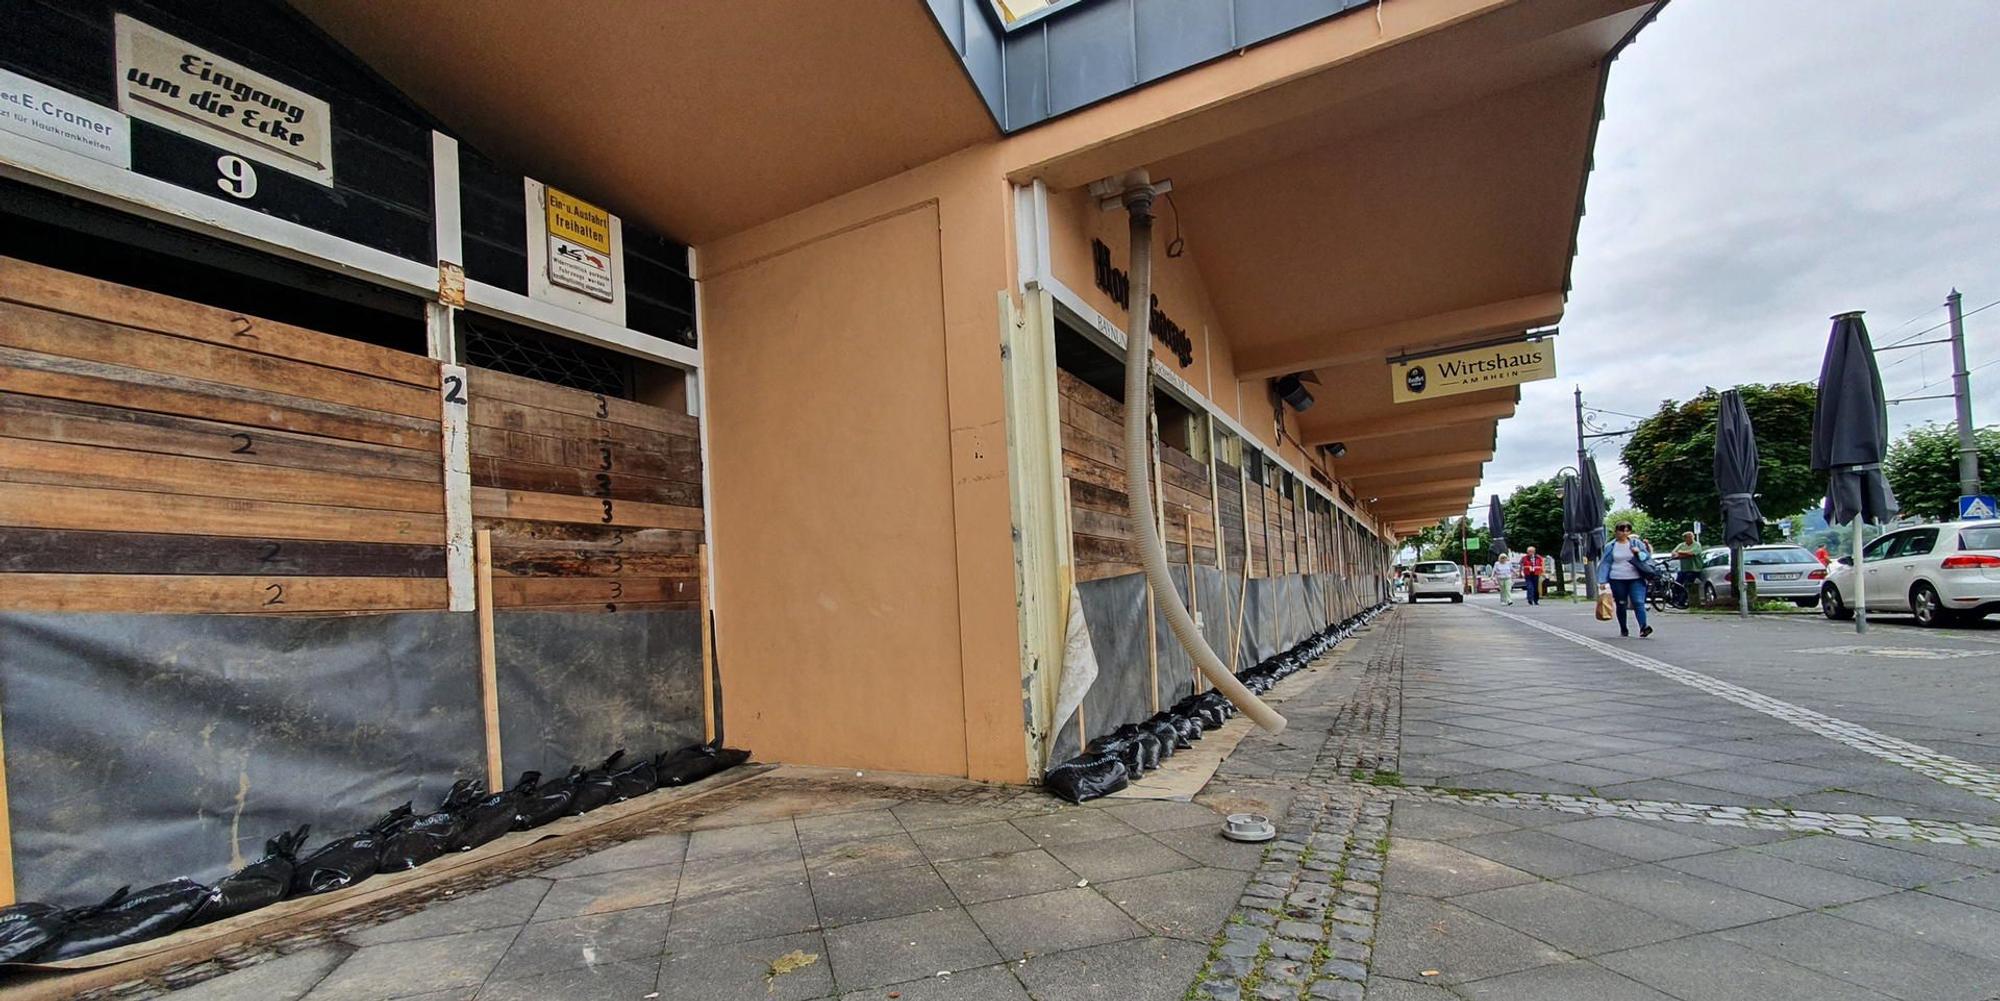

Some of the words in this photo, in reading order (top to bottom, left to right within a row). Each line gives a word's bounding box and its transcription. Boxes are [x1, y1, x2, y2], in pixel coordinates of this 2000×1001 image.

[180, 54, 305, 124] Eingang
[0, 91, 21, 105] ed.
[41, 101, 112, 136] Cramer
[127, 67, 181, 98] um
[189, 91, 234, 118] die
[241, 109, 305, 146] Ecke
[14, 112, 28, 123] für
[32, 119, 111, 151] Hautkrankheiten
[216, 155, 258, 199] 9
[556, 214, 604, 244] freihalten
[230, 317, 259, 340] 2
[1438, 351, 1543, 379] Wirtshaus
[1462, 376, 1479, 385] AM
[1483, 370, 1520, 382] RHEIN
[444, 376, 467, 405] 2
[594, 393, 611, 419] 3
[230, 433, 257, 455] 2
[601, 500, 613, 524] 3
[262, 583, 284, 606] 2
[609, 581, 623, 600] 3
